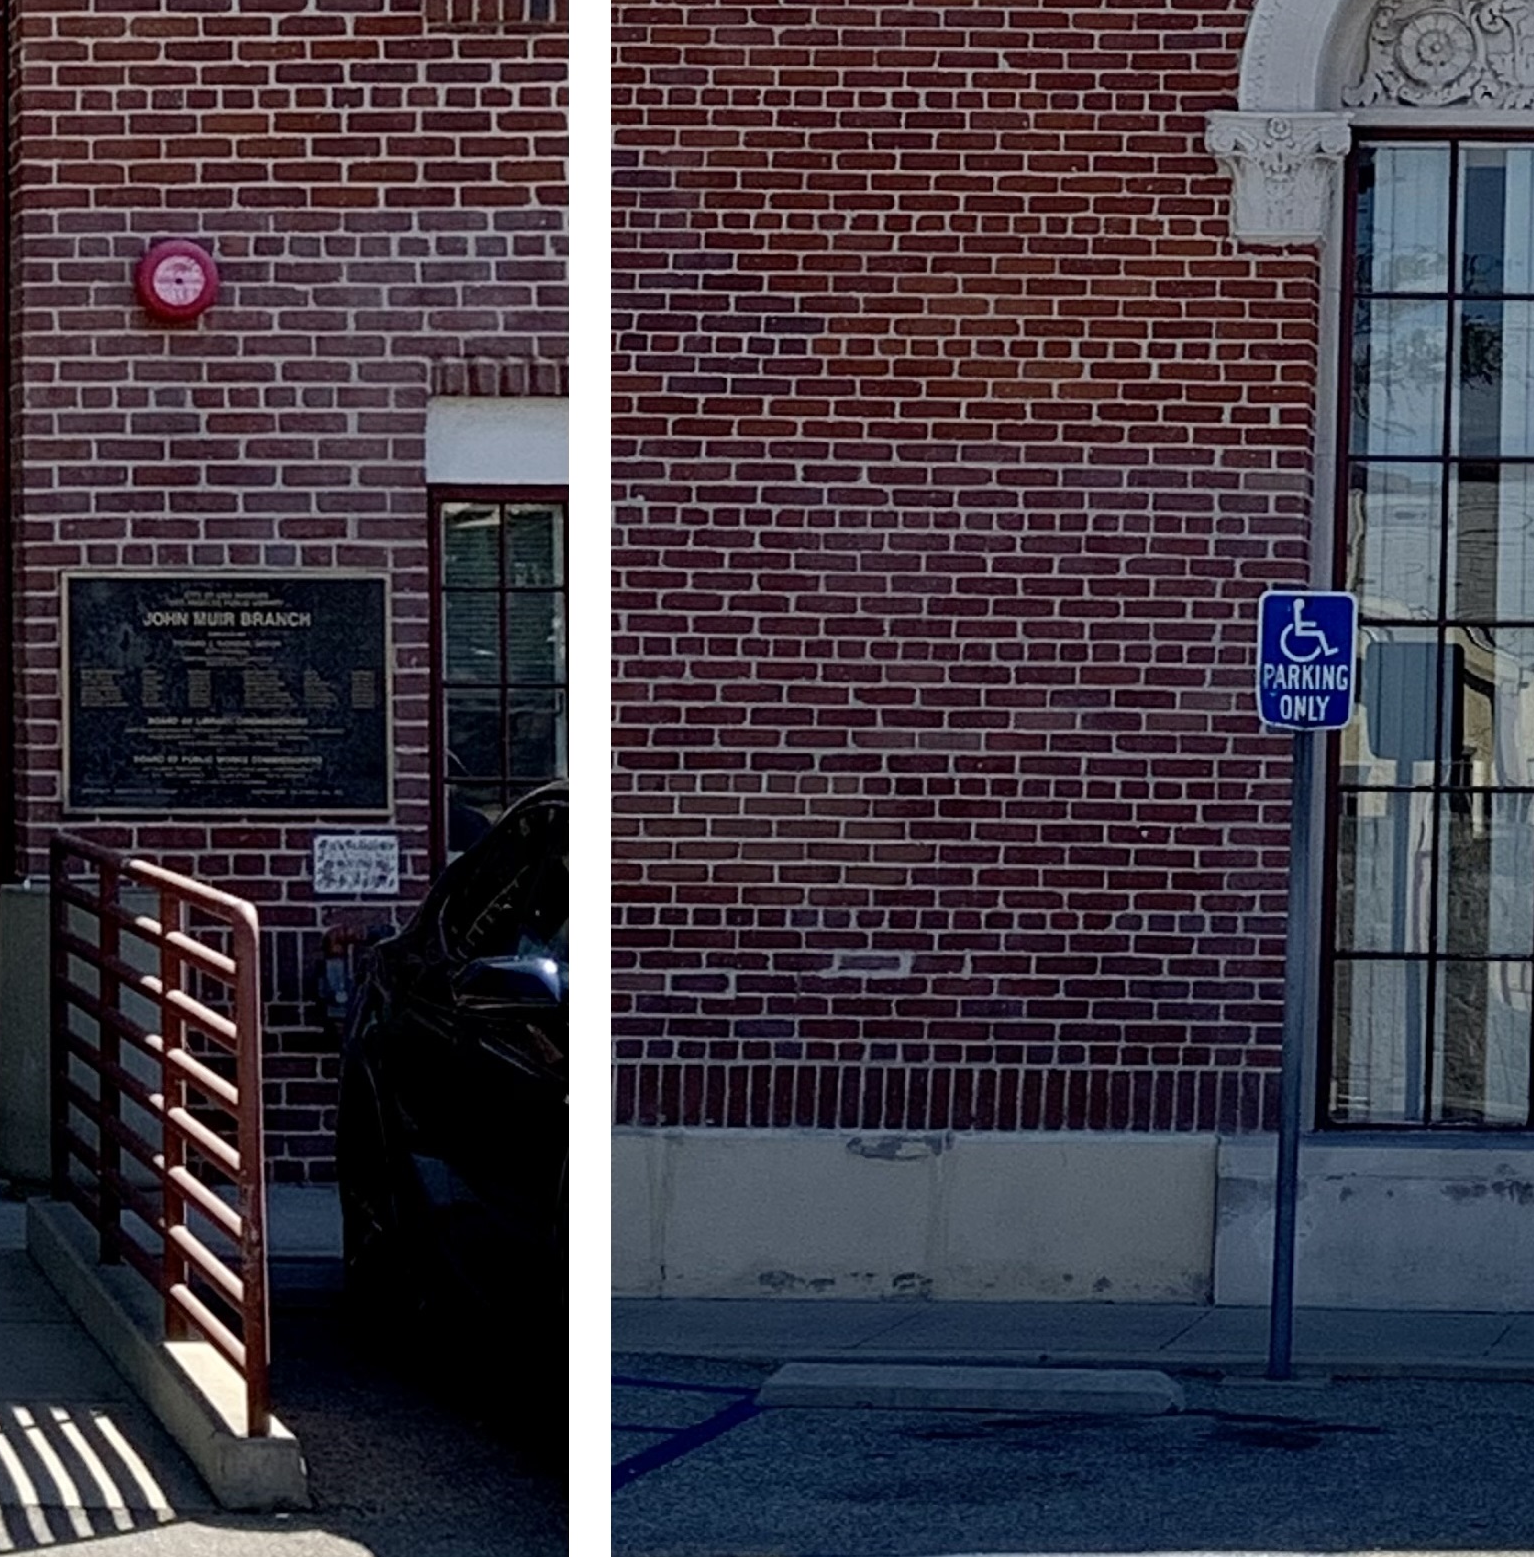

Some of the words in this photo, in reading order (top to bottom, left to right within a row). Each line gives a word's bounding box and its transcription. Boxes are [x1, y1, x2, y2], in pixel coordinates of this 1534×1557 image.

[143, 611, 189, 627] JOHN
[193, 611, 235, 627] MUIR
[240, 611, 311, 627] BRANCH
[1262, 662, 1349, 691] PARKING
[1279, 694, 1331, 722] ONLY
